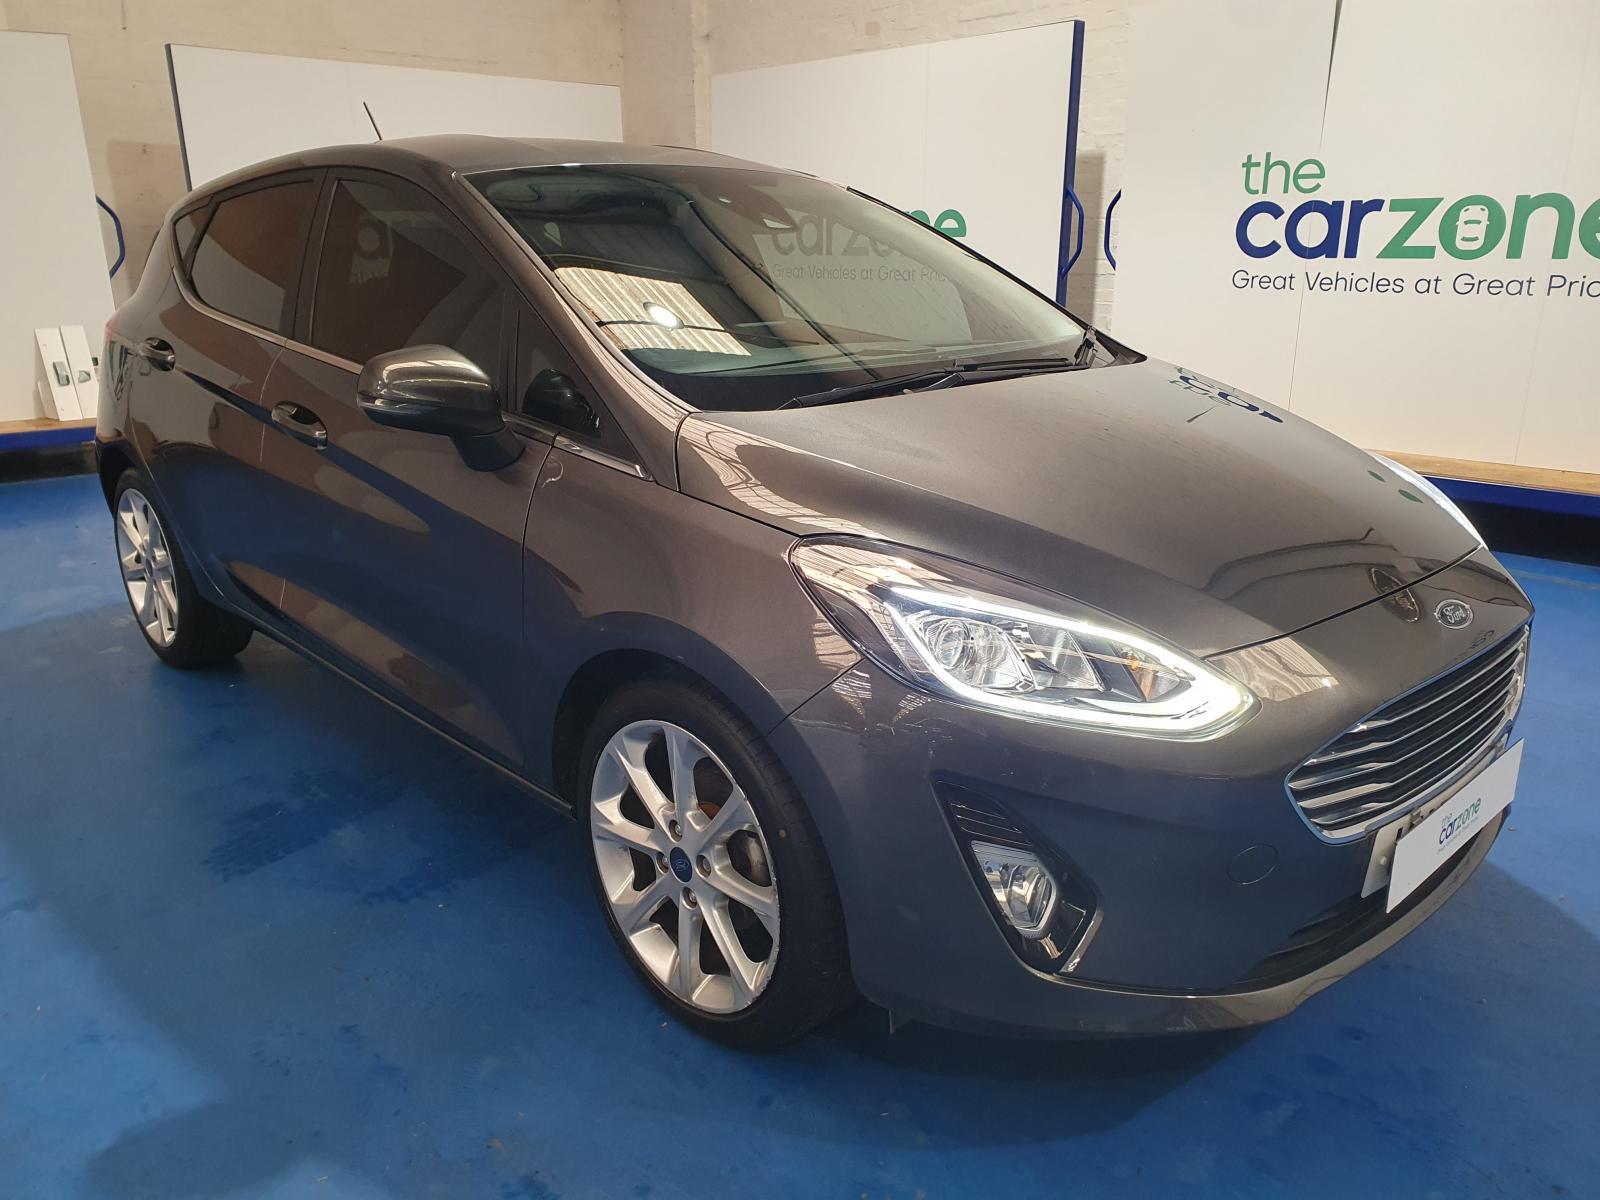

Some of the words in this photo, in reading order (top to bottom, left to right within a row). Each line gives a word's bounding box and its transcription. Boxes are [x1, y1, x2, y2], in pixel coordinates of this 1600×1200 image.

[1241, 151, 1326, 195] the
[772, 264, 805, 280] Great
[860, 267, 874, 281] at
[878, 266, 916, 282] Great
[1231, 269, 1296, 291] Great
[1304, 271, 1405, 294] Vehicles
[1414, 274, 1443, 295] at
[1452, 272, 1536, 297] Great
[1439, 797, 1482, 845] carzone
